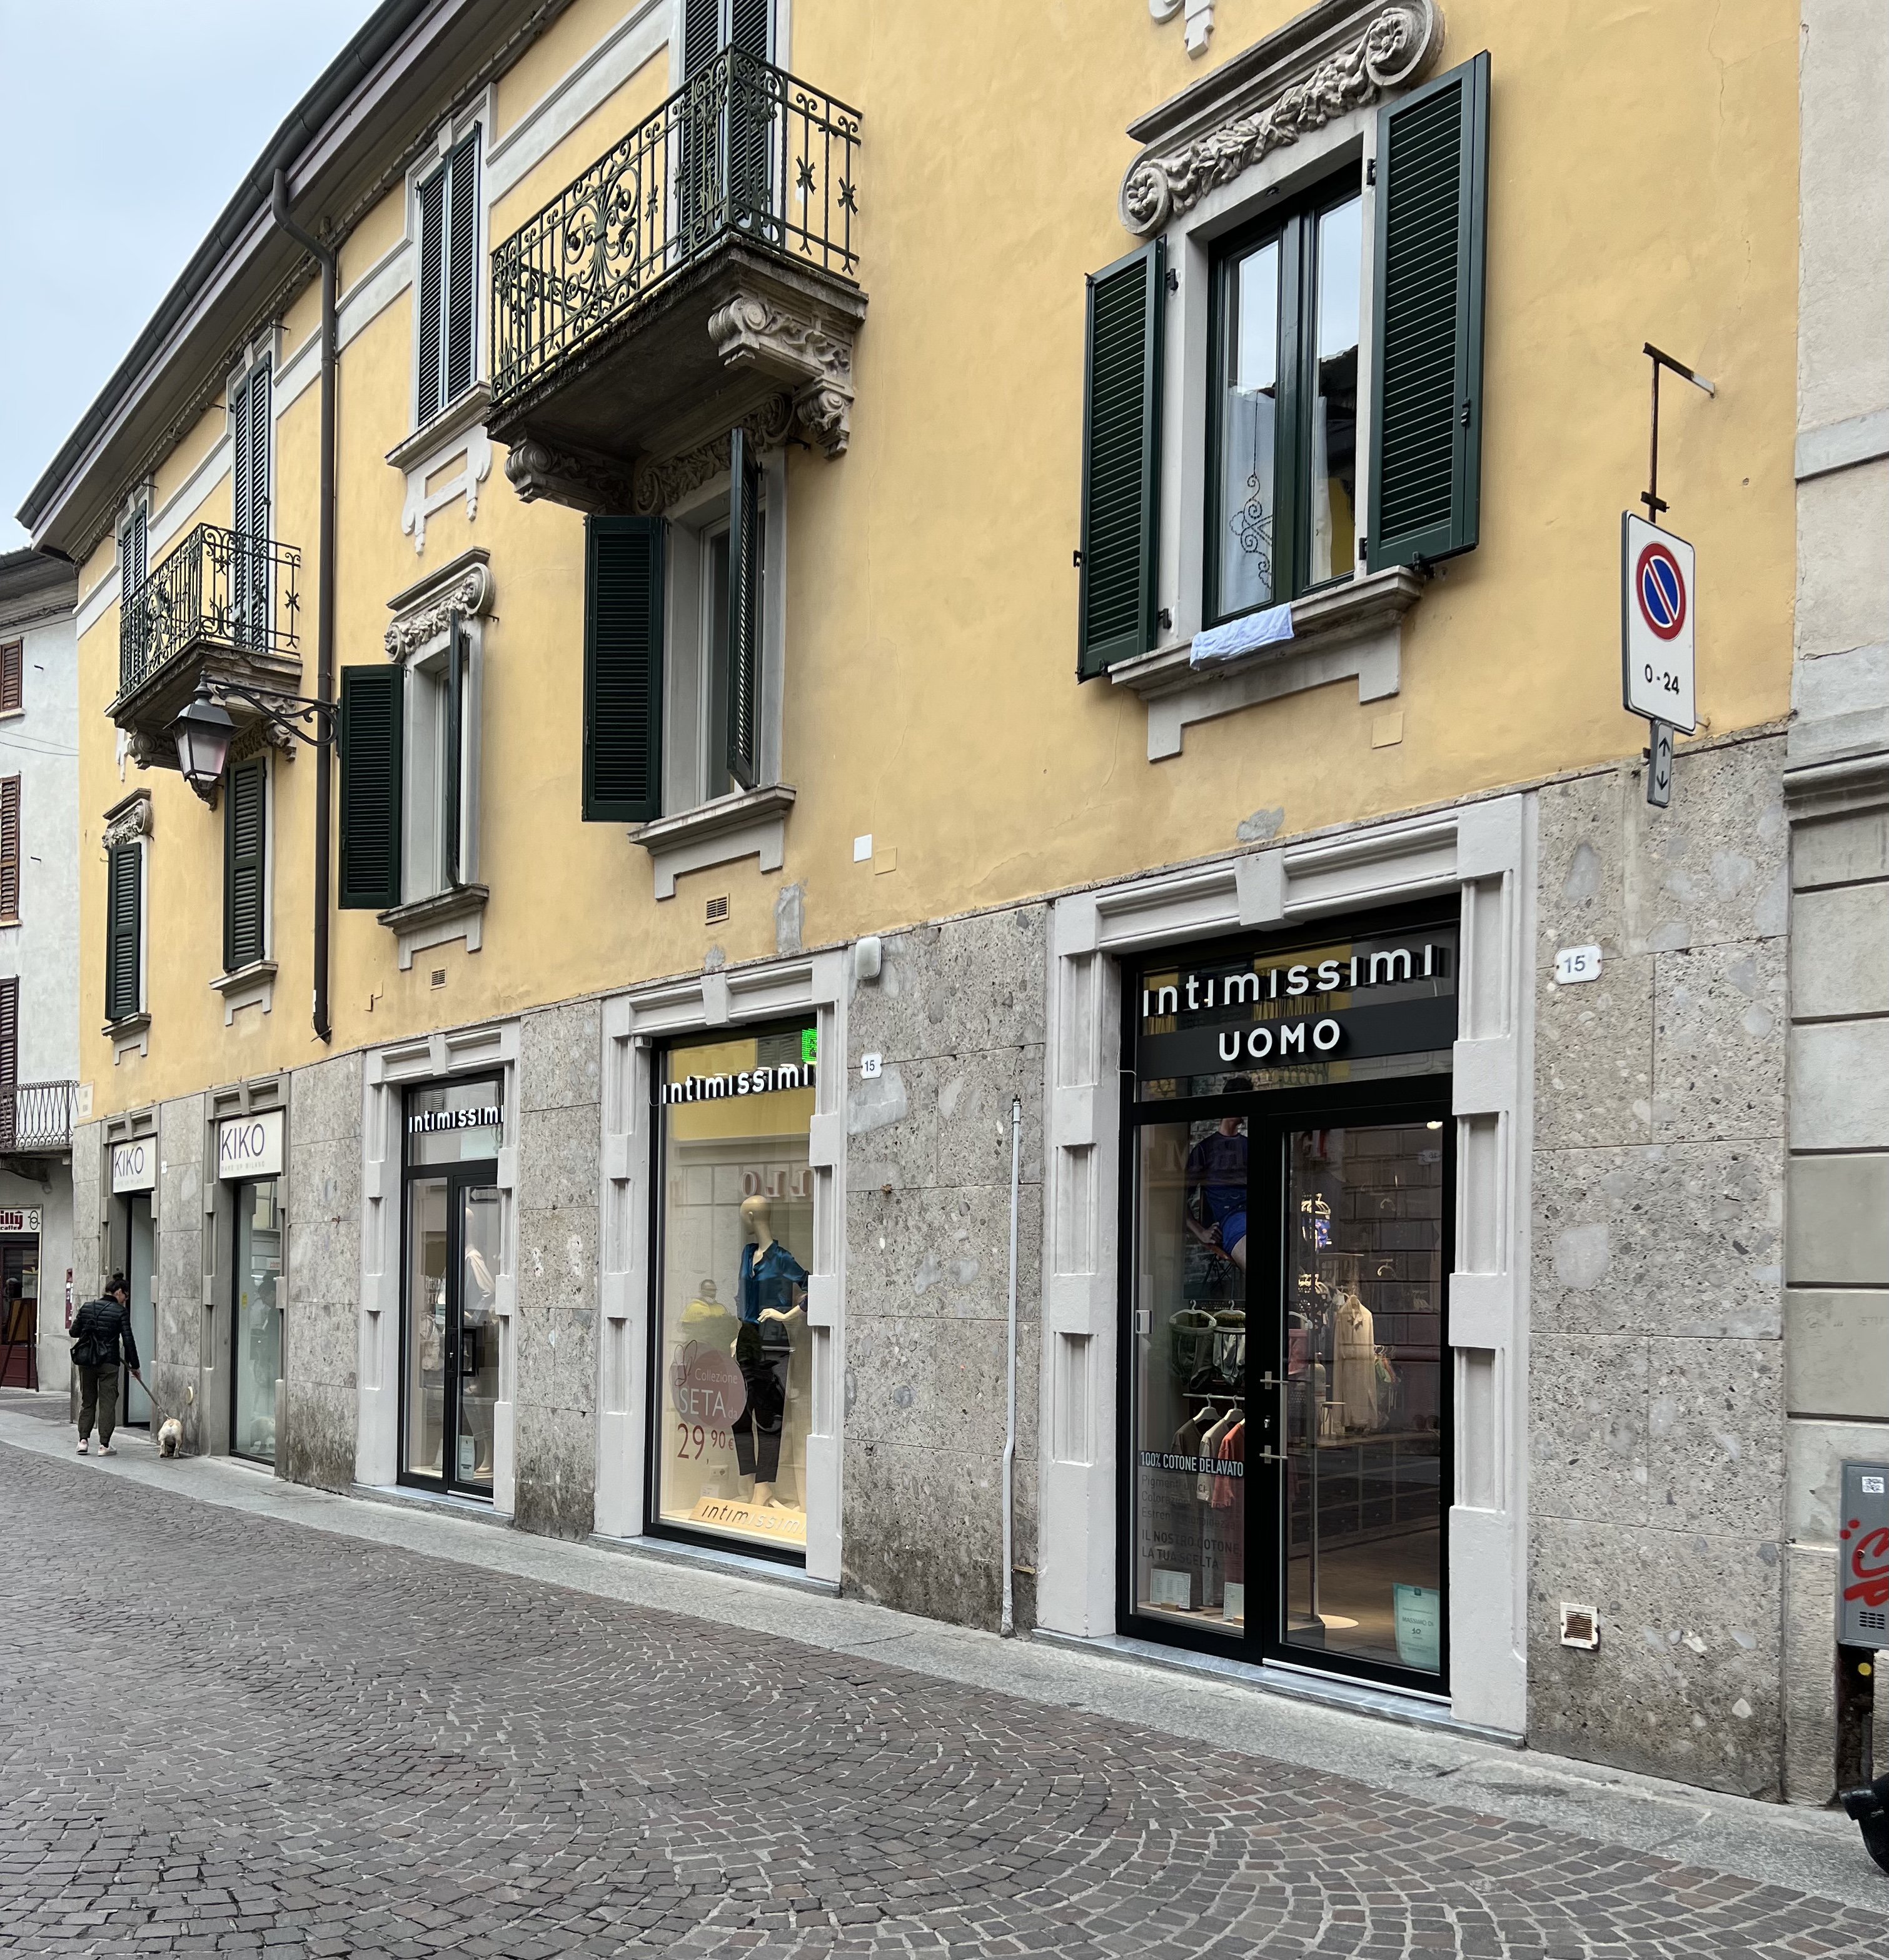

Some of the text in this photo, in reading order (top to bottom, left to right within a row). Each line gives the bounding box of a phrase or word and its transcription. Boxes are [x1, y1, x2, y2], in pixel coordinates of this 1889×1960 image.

[1564, 955, 1585, 973] 15
[1143, 943, 1433, 1017] intimissimi
[1219, 1018, 1340, 1061] UOMO
[865, 1060, 875, 1072] 15
[663, 1063, 808, 1103] intimissimi
[409, 1105, 504, 1133] intimissimi
[222, 1123, 264, 1161] KIKO
[114, 1146, 144, 1177] KIKO
[695, 1368, 738, 1384] Collezione
[679, 1387, 737, 1419] SETA da
[1141, 1452, 1244, 1477] 100% COTONE DELAVATO
[702, 1505, 807, 1534] intimissimi
[1142, 1529, 1151, 1541] IL
[1142, 1546, 1154, 1559] LA
[1157, 1549, 1176, 1561] TUA
